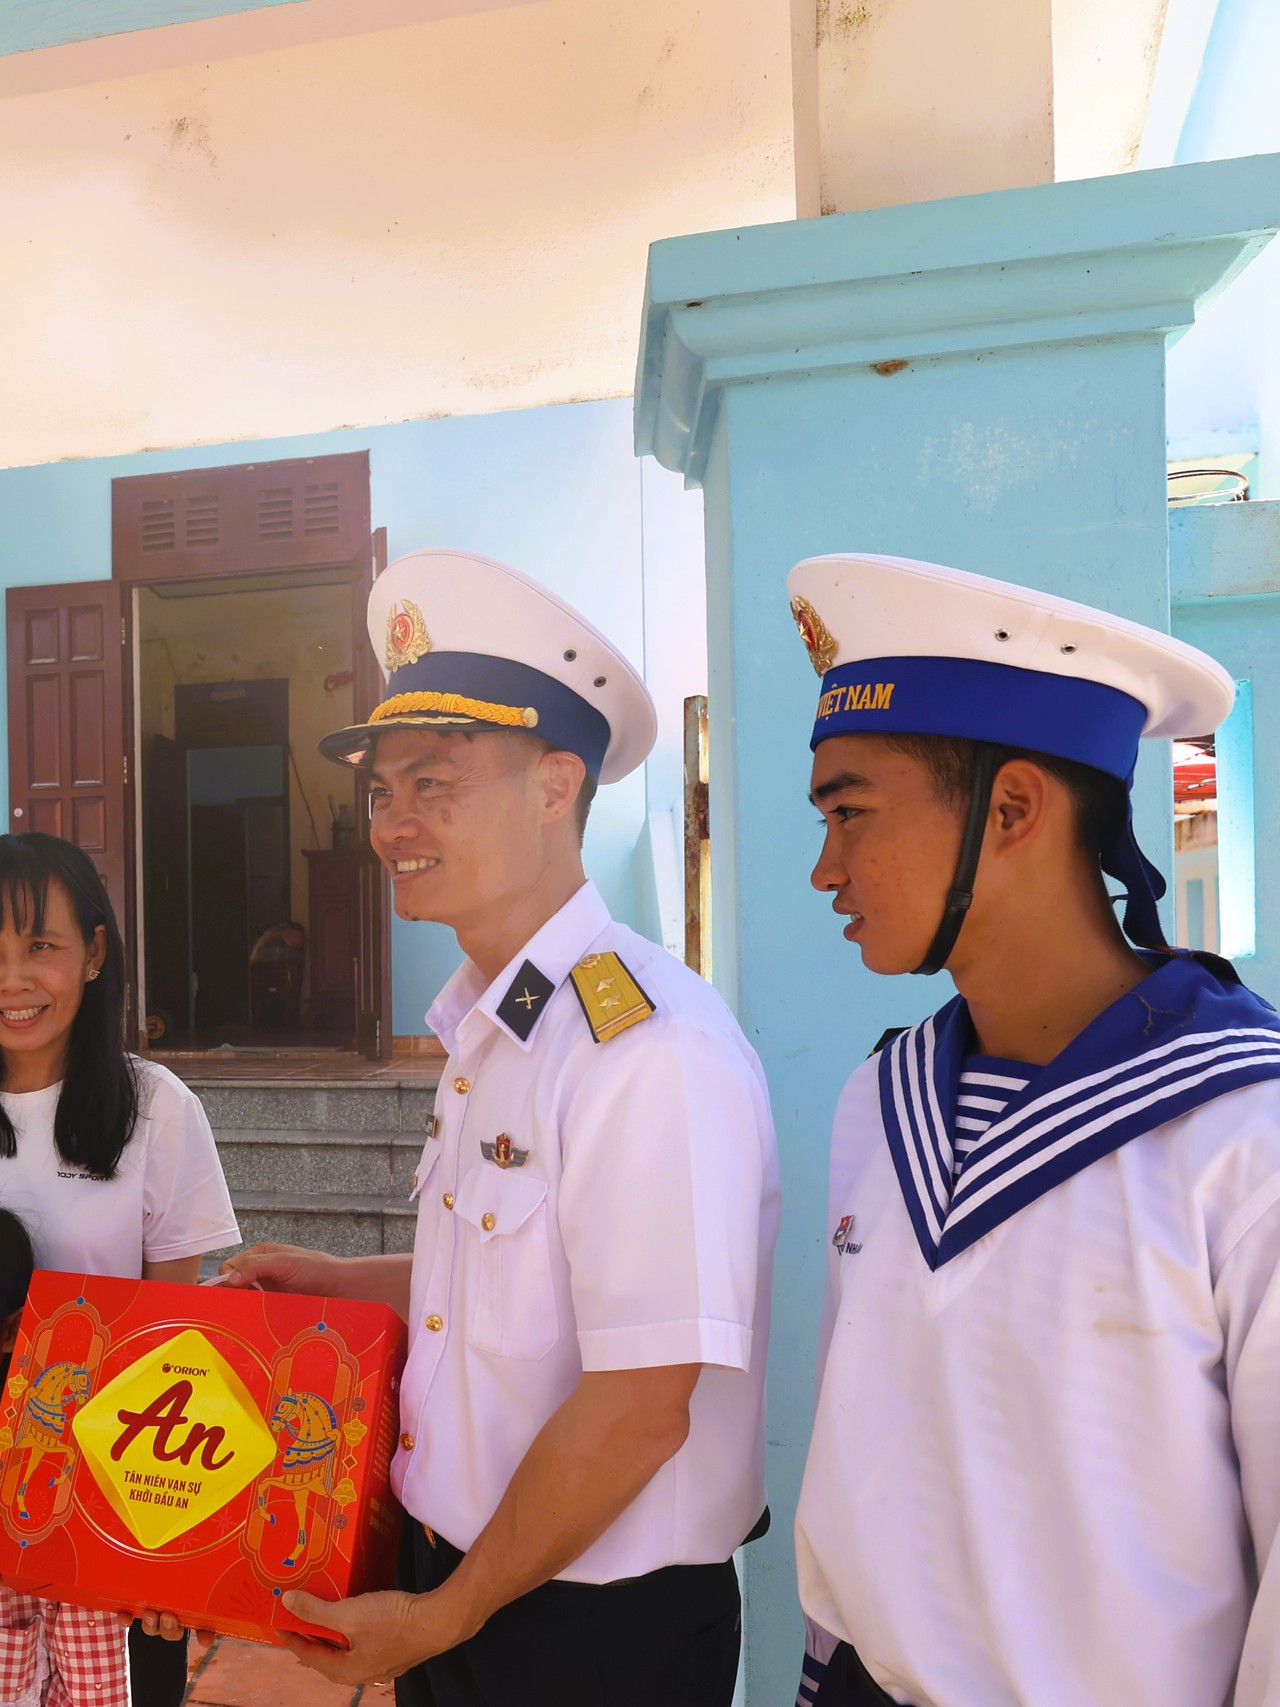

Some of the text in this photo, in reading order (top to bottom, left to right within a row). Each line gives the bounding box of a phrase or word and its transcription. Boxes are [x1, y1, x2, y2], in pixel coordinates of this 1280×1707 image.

[844, 683, 895, 711] NAM
[110, 1379, 235, 1471] An
[124, 1470, 203, 1496] TÂN NIÊN VẠN SỰ
[175, 1498, 189, 1509] AN
